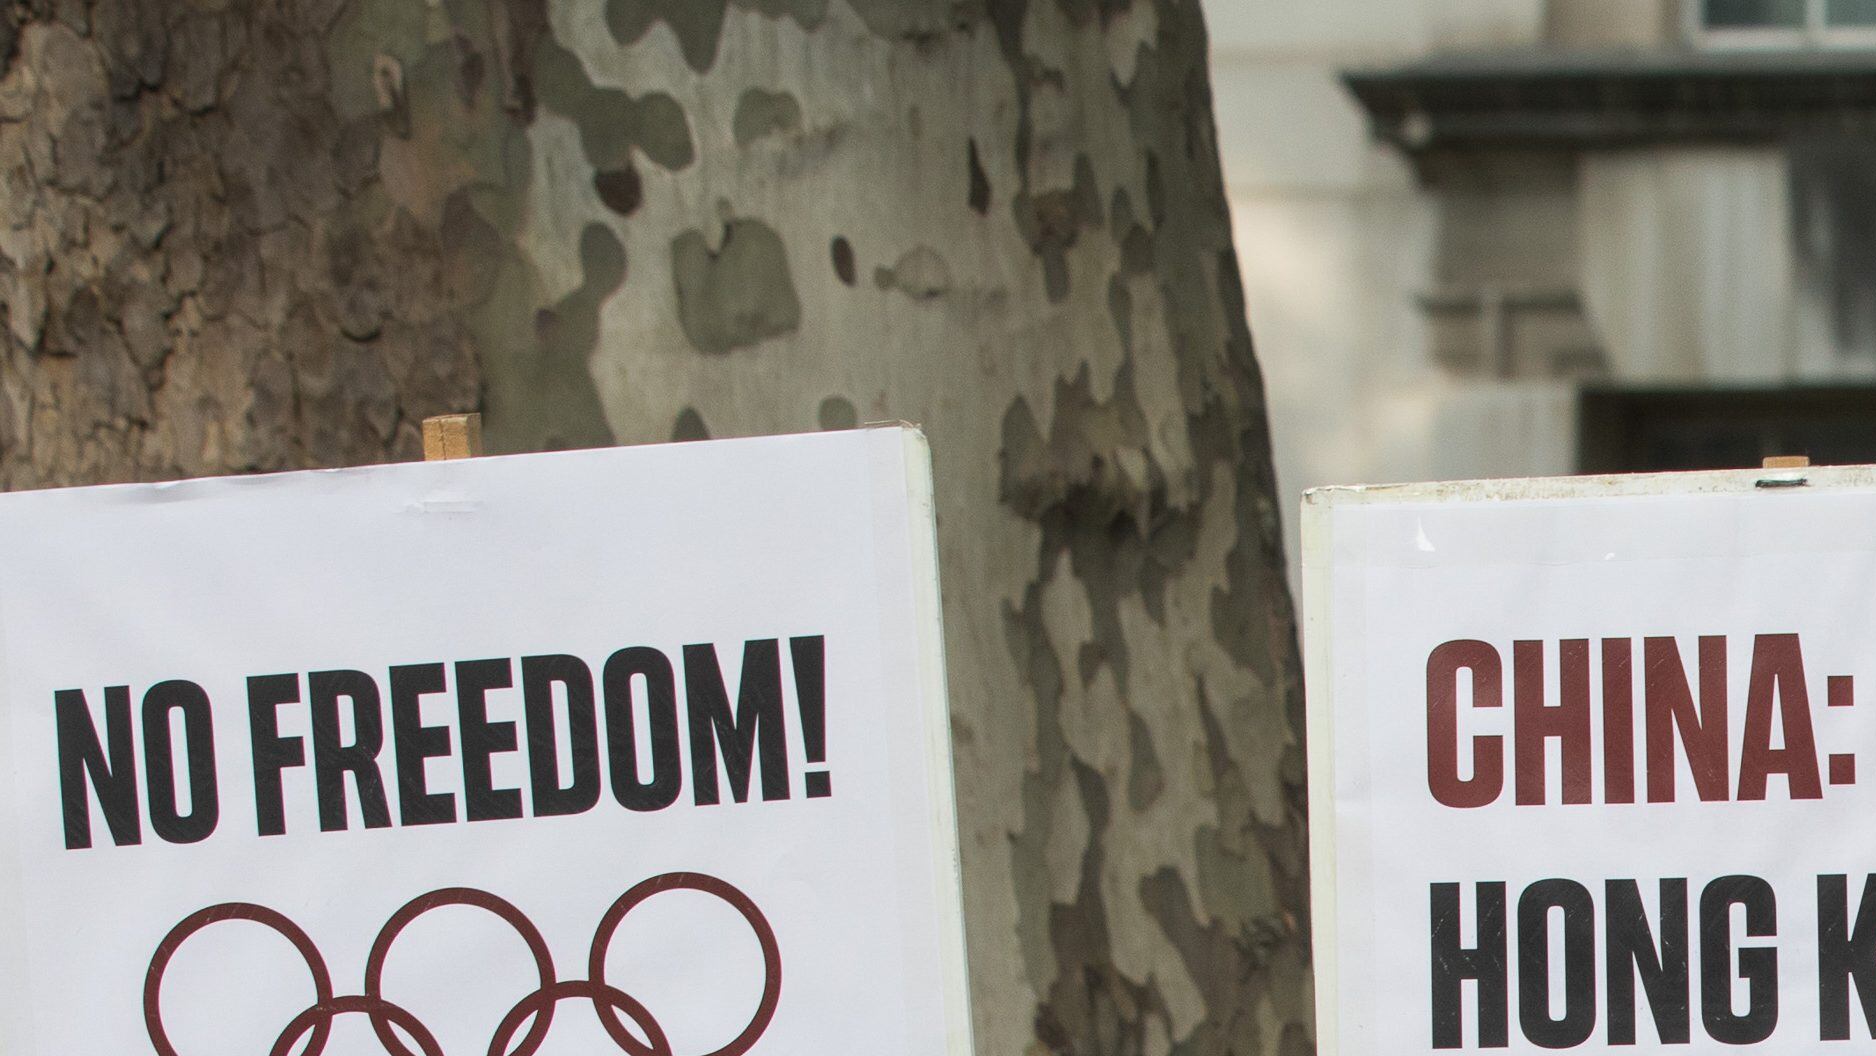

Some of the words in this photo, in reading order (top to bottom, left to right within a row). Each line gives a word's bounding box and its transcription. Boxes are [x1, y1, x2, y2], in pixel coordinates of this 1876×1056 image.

[54, 680, 220, 850] NO
[246, 634, 832, 836] FREEDOM!
[1426, 632, 1856, 808] CHINA:
[1430, 875, 1778, 1049] HONG
